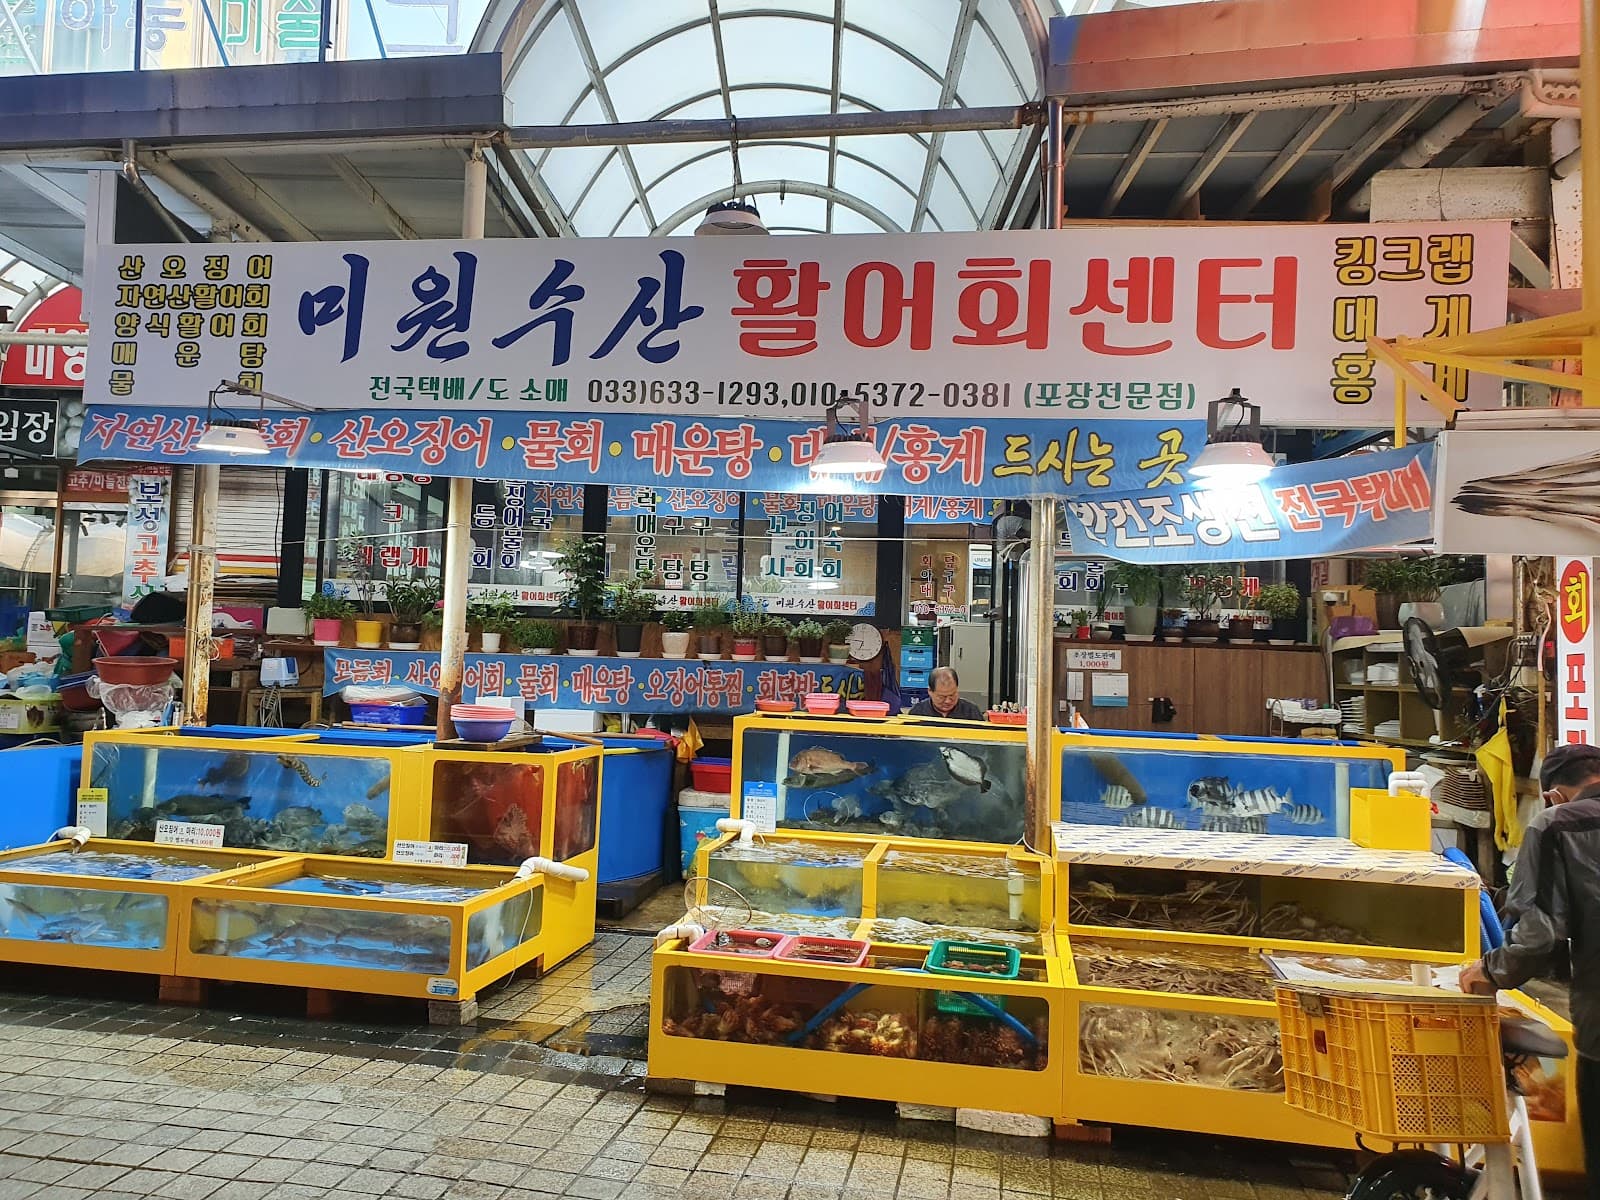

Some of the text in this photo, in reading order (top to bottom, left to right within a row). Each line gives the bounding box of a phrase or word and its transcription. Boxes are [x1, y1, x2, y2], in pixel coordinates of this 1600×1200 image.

[118, 254, 272, 281] 산오징어
[1334, 234, 1474, 286] 킹크랩
[115, 283, 271, 310] 자연산활어회
[298, 250, 1298, 366] 미원수산 활어회센터
[114, 312, 269, 339] 양식활어회
[111, 341, 267, 369] 매운탕
[1023, 382, 1196, 410] (포장전문점)
[85, 413, 313, 457] 자연산회
[328, 415, 493, 469] 산오징어
[519, 419, 605, 475] 물회
[631, 421, 763, 479] 매운탕
[992, 427, 1116, 488] 드시는
[1564, 571, 1587, 633] 회
[518, 663, 558, 702] 물회
[571, 664, 633, 706] 매운탕
[644, 667, 743, 708] 오징어통찜
